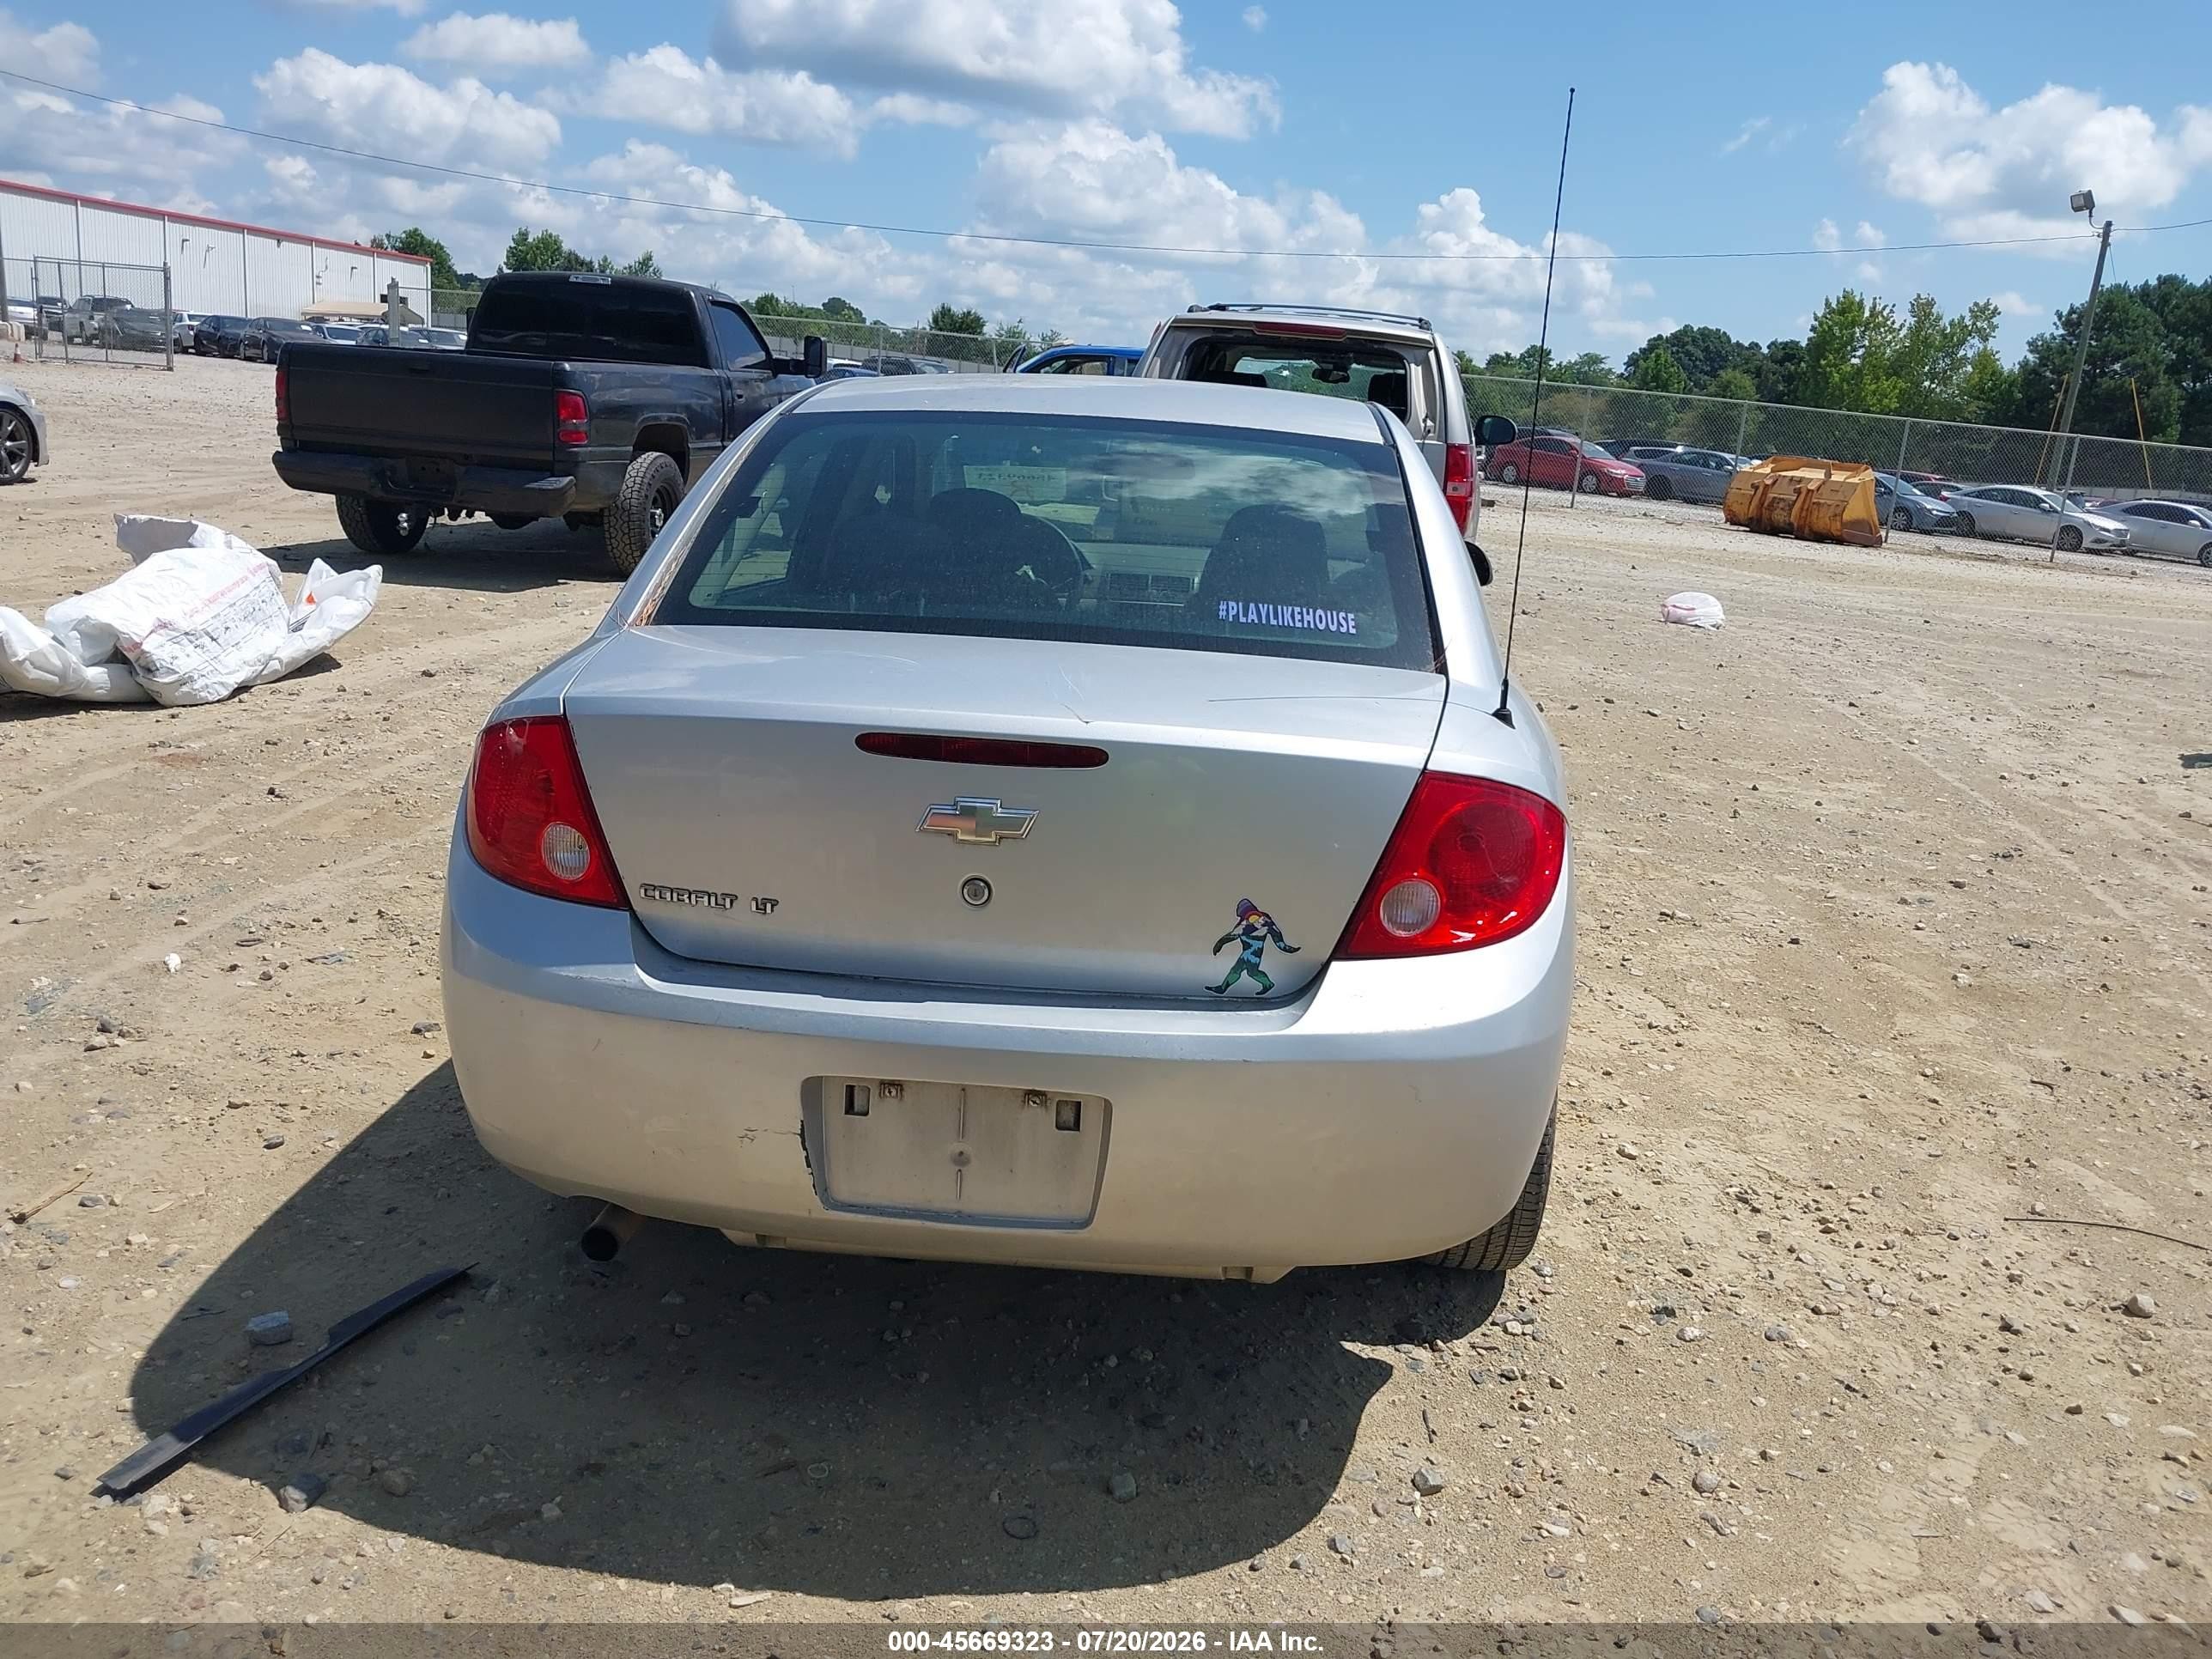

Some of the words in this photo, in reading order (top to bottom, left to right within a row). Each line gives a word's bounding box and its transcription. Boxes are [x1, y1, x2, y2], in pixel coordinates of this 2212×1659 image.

[1218, 600, 1357, 635] #PLAYLIKEHOUSE
[640, 884, 738, 909] COBALT
[750, 897, 780, 915] LT
